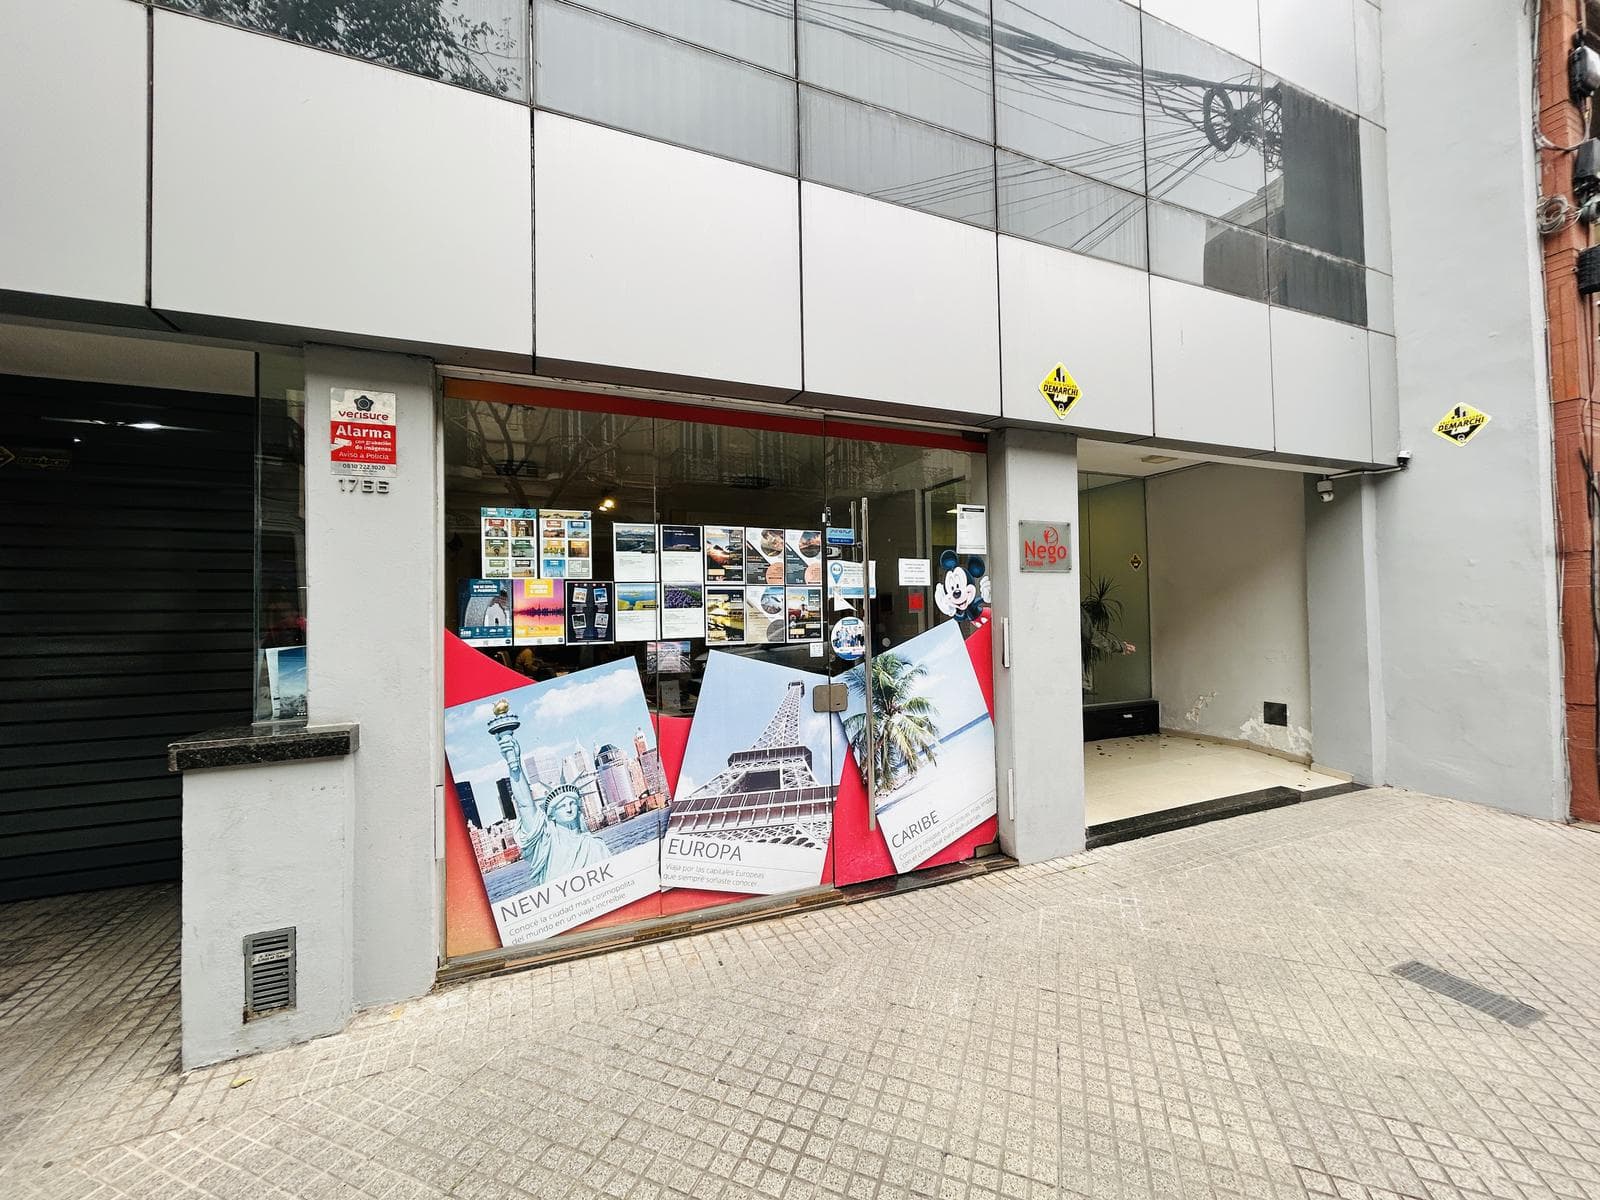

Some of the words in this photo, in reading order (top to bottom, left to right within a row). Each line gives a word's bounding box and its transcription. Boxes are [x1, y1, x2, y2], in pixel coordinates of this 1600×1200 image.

[1043, 384, 1079, 396] DEMARCHI
[338, 410, 389, 421] verisure
[1438, 416, 1485, 431] DEMARCHI
[336, 425, 392, 439] Alarma
[1024, 540, 1067, 564] Nego
[891, 810, 939, 848] CARIBE
[667, 839, 742, 861] EUROPA
[663, 873, 677, 882] que
[696, 864, 705, 873] las
[735, 870, 765, 880] Europeas
[501, 887, 550, 922] NEW
[555, 863, 614, 898] YORK
[540, 912, 548, 923] la
[549, 902, 575, 920] ciudad
[592, 879, 635, 901] cosmopolita
[511, 932, 526, 945] del
[526, 922, 553, 939] mundo
[554, 918, 566, 930] en
[566, 913, 578, 924] un
[577, 905, 595, 920] viaje
